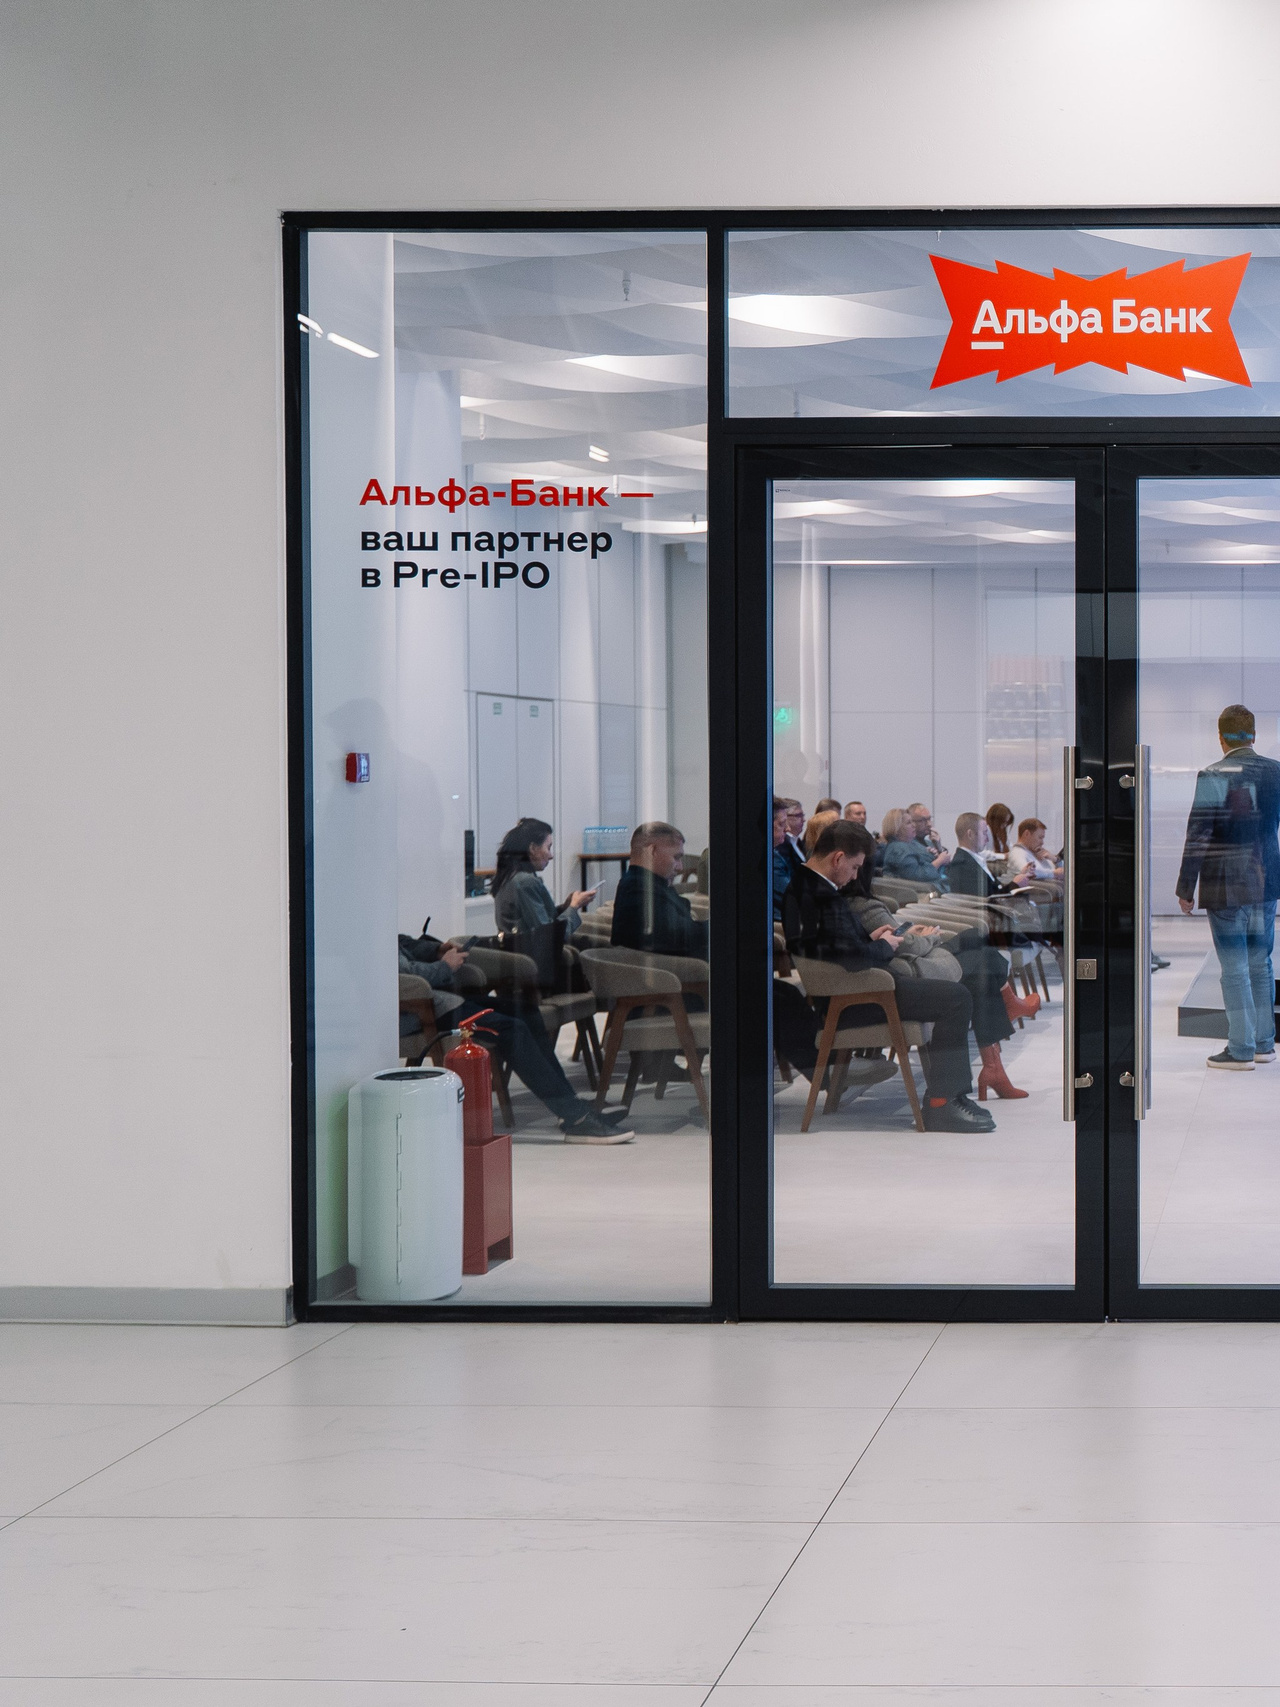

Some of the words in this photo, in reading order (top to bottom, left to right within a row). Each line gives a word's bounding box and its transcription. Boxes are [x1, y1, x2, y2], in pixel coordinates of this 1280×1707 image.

[972, 300, 1104, 350] Альфа
[1113, 299, 1213, 334] Банк
[360, 477, 610, 513] Альфа-Банк
[361, 531, 439, 552] ваш
[452, 531, 614, 560] партнер
[361, 567, 382, 588] в
[394, 561, 551, 590] Pre-IPO
